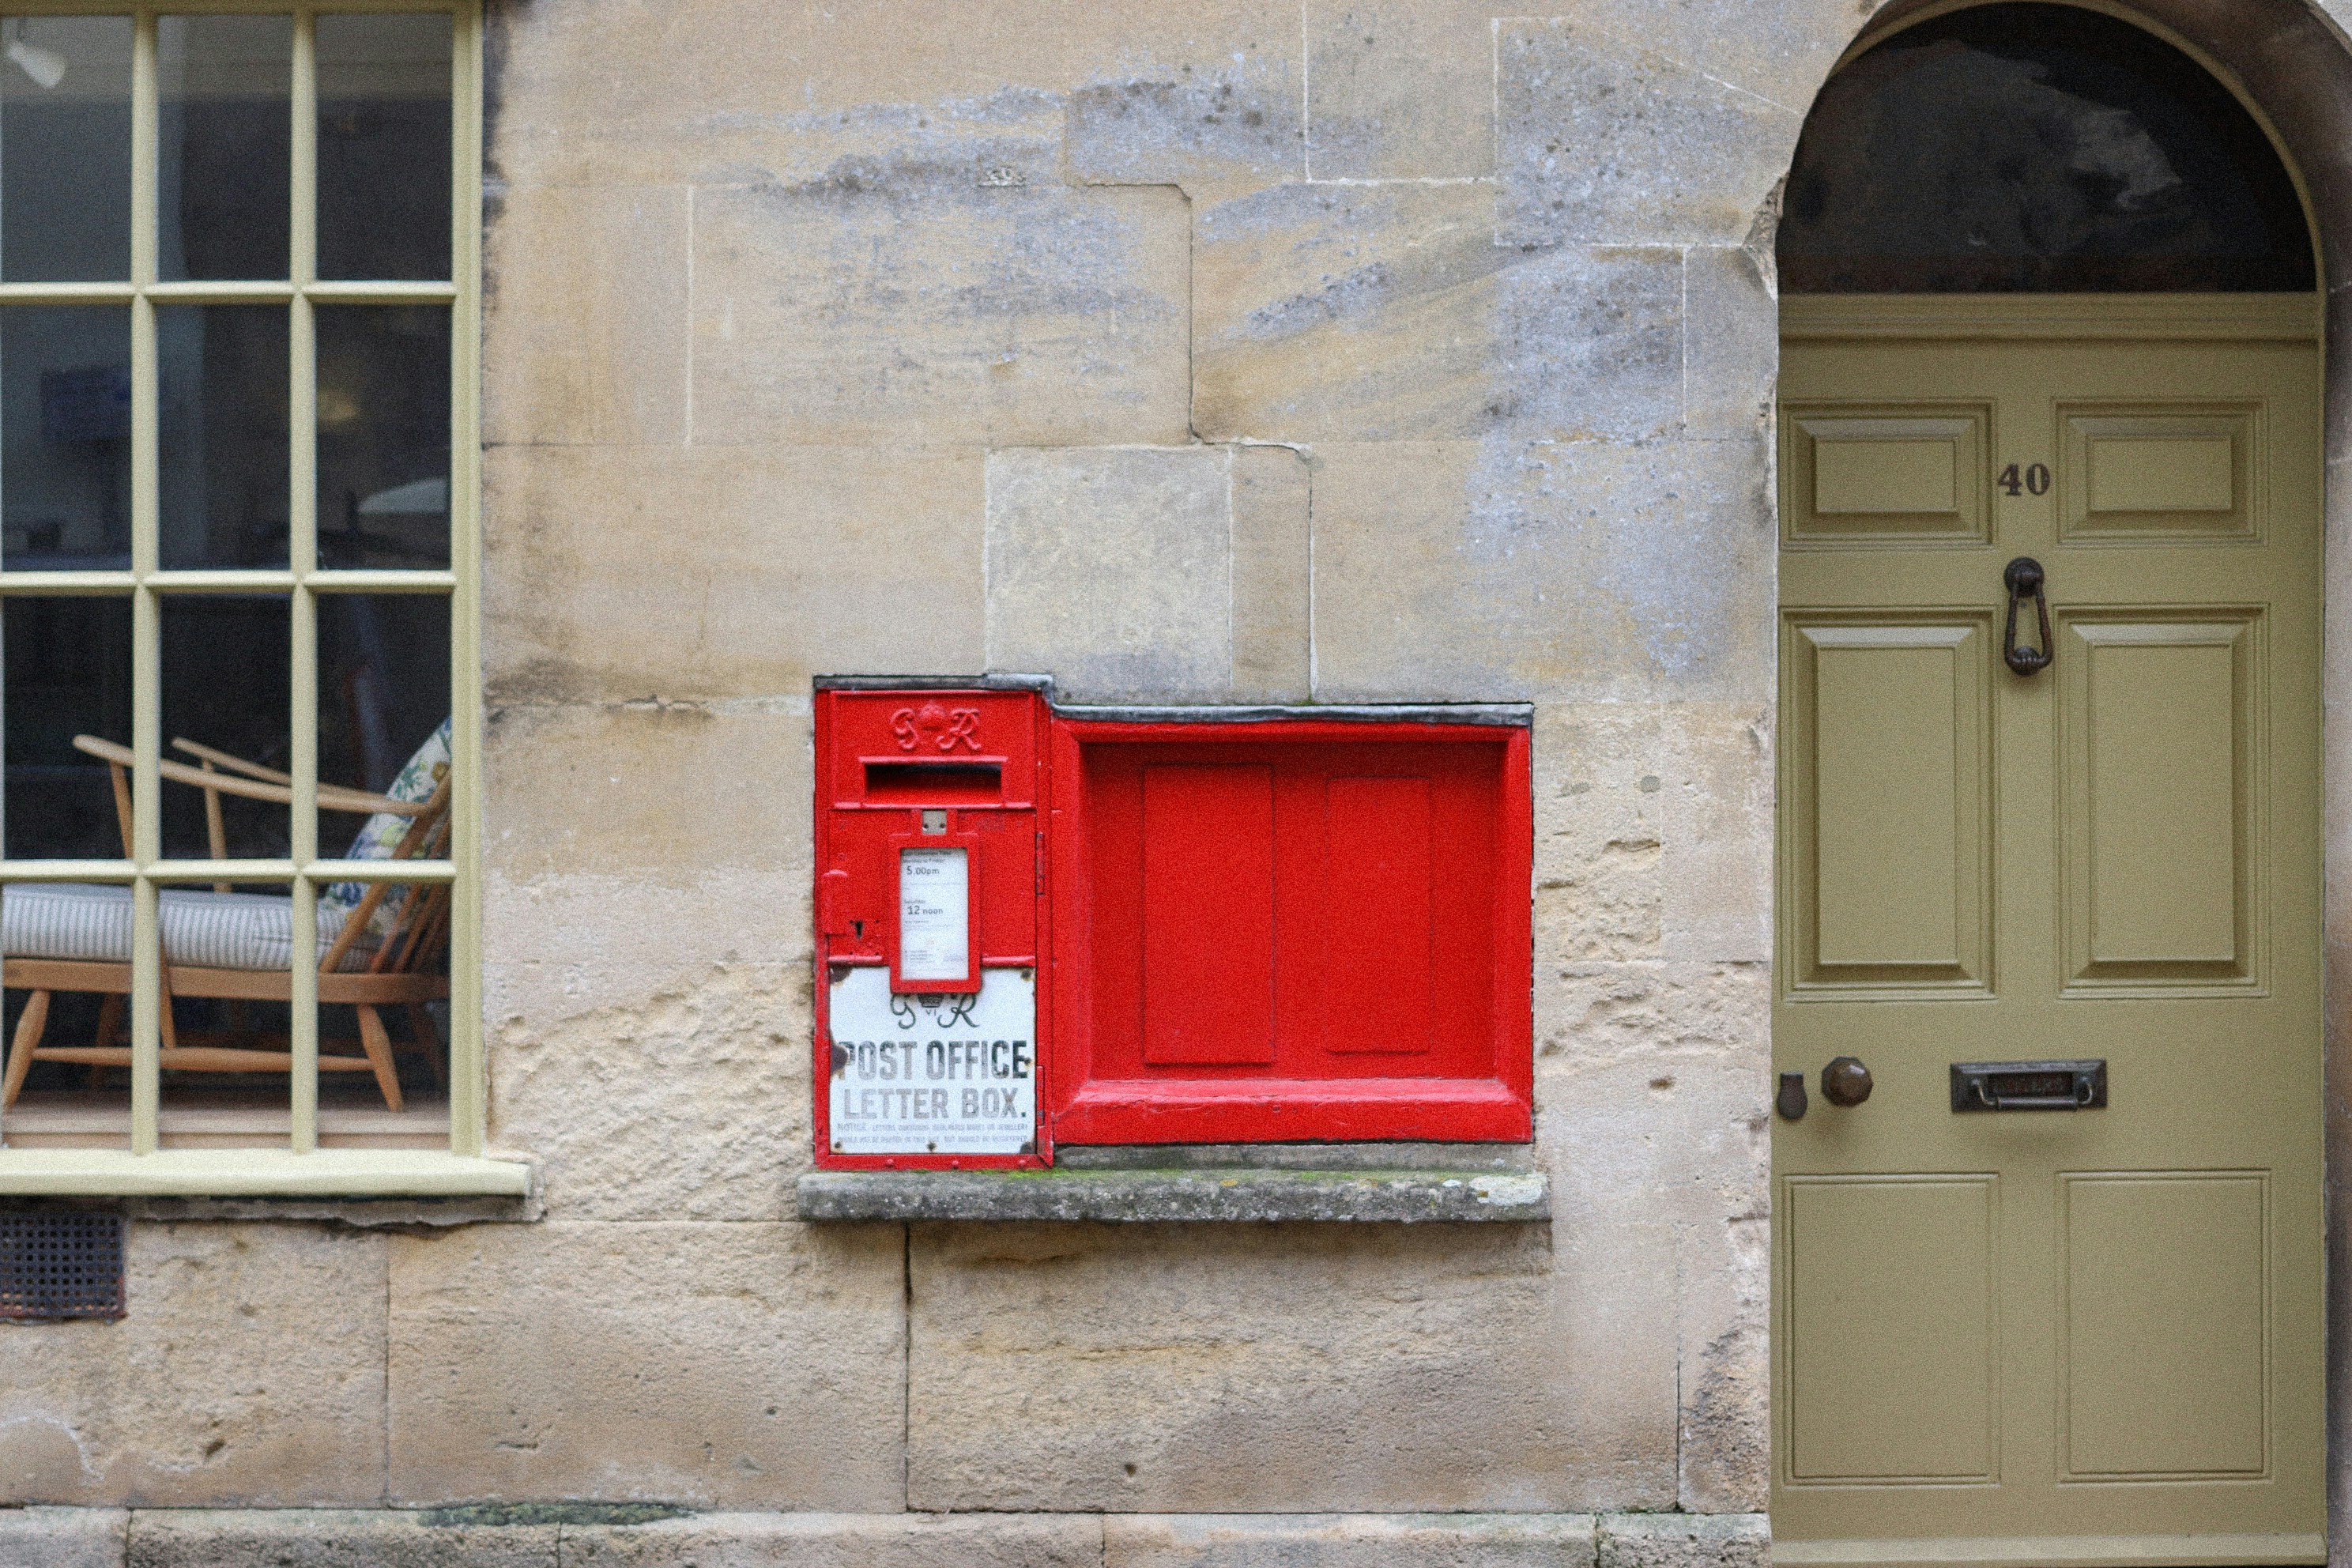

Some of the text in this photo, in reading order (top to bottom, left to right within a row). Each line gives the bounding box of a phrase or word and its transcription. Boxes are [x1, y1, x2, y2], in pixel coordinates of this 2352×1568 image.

[1997, 463, 2051, 496] 40
[906, 865, 940, 876] 5.00pm
[907, 905, 920, 915] 12
[925, 1040, 1028, 1080] OFFICE
[843, 1087, 1027, 1120] LETTER BOX.
